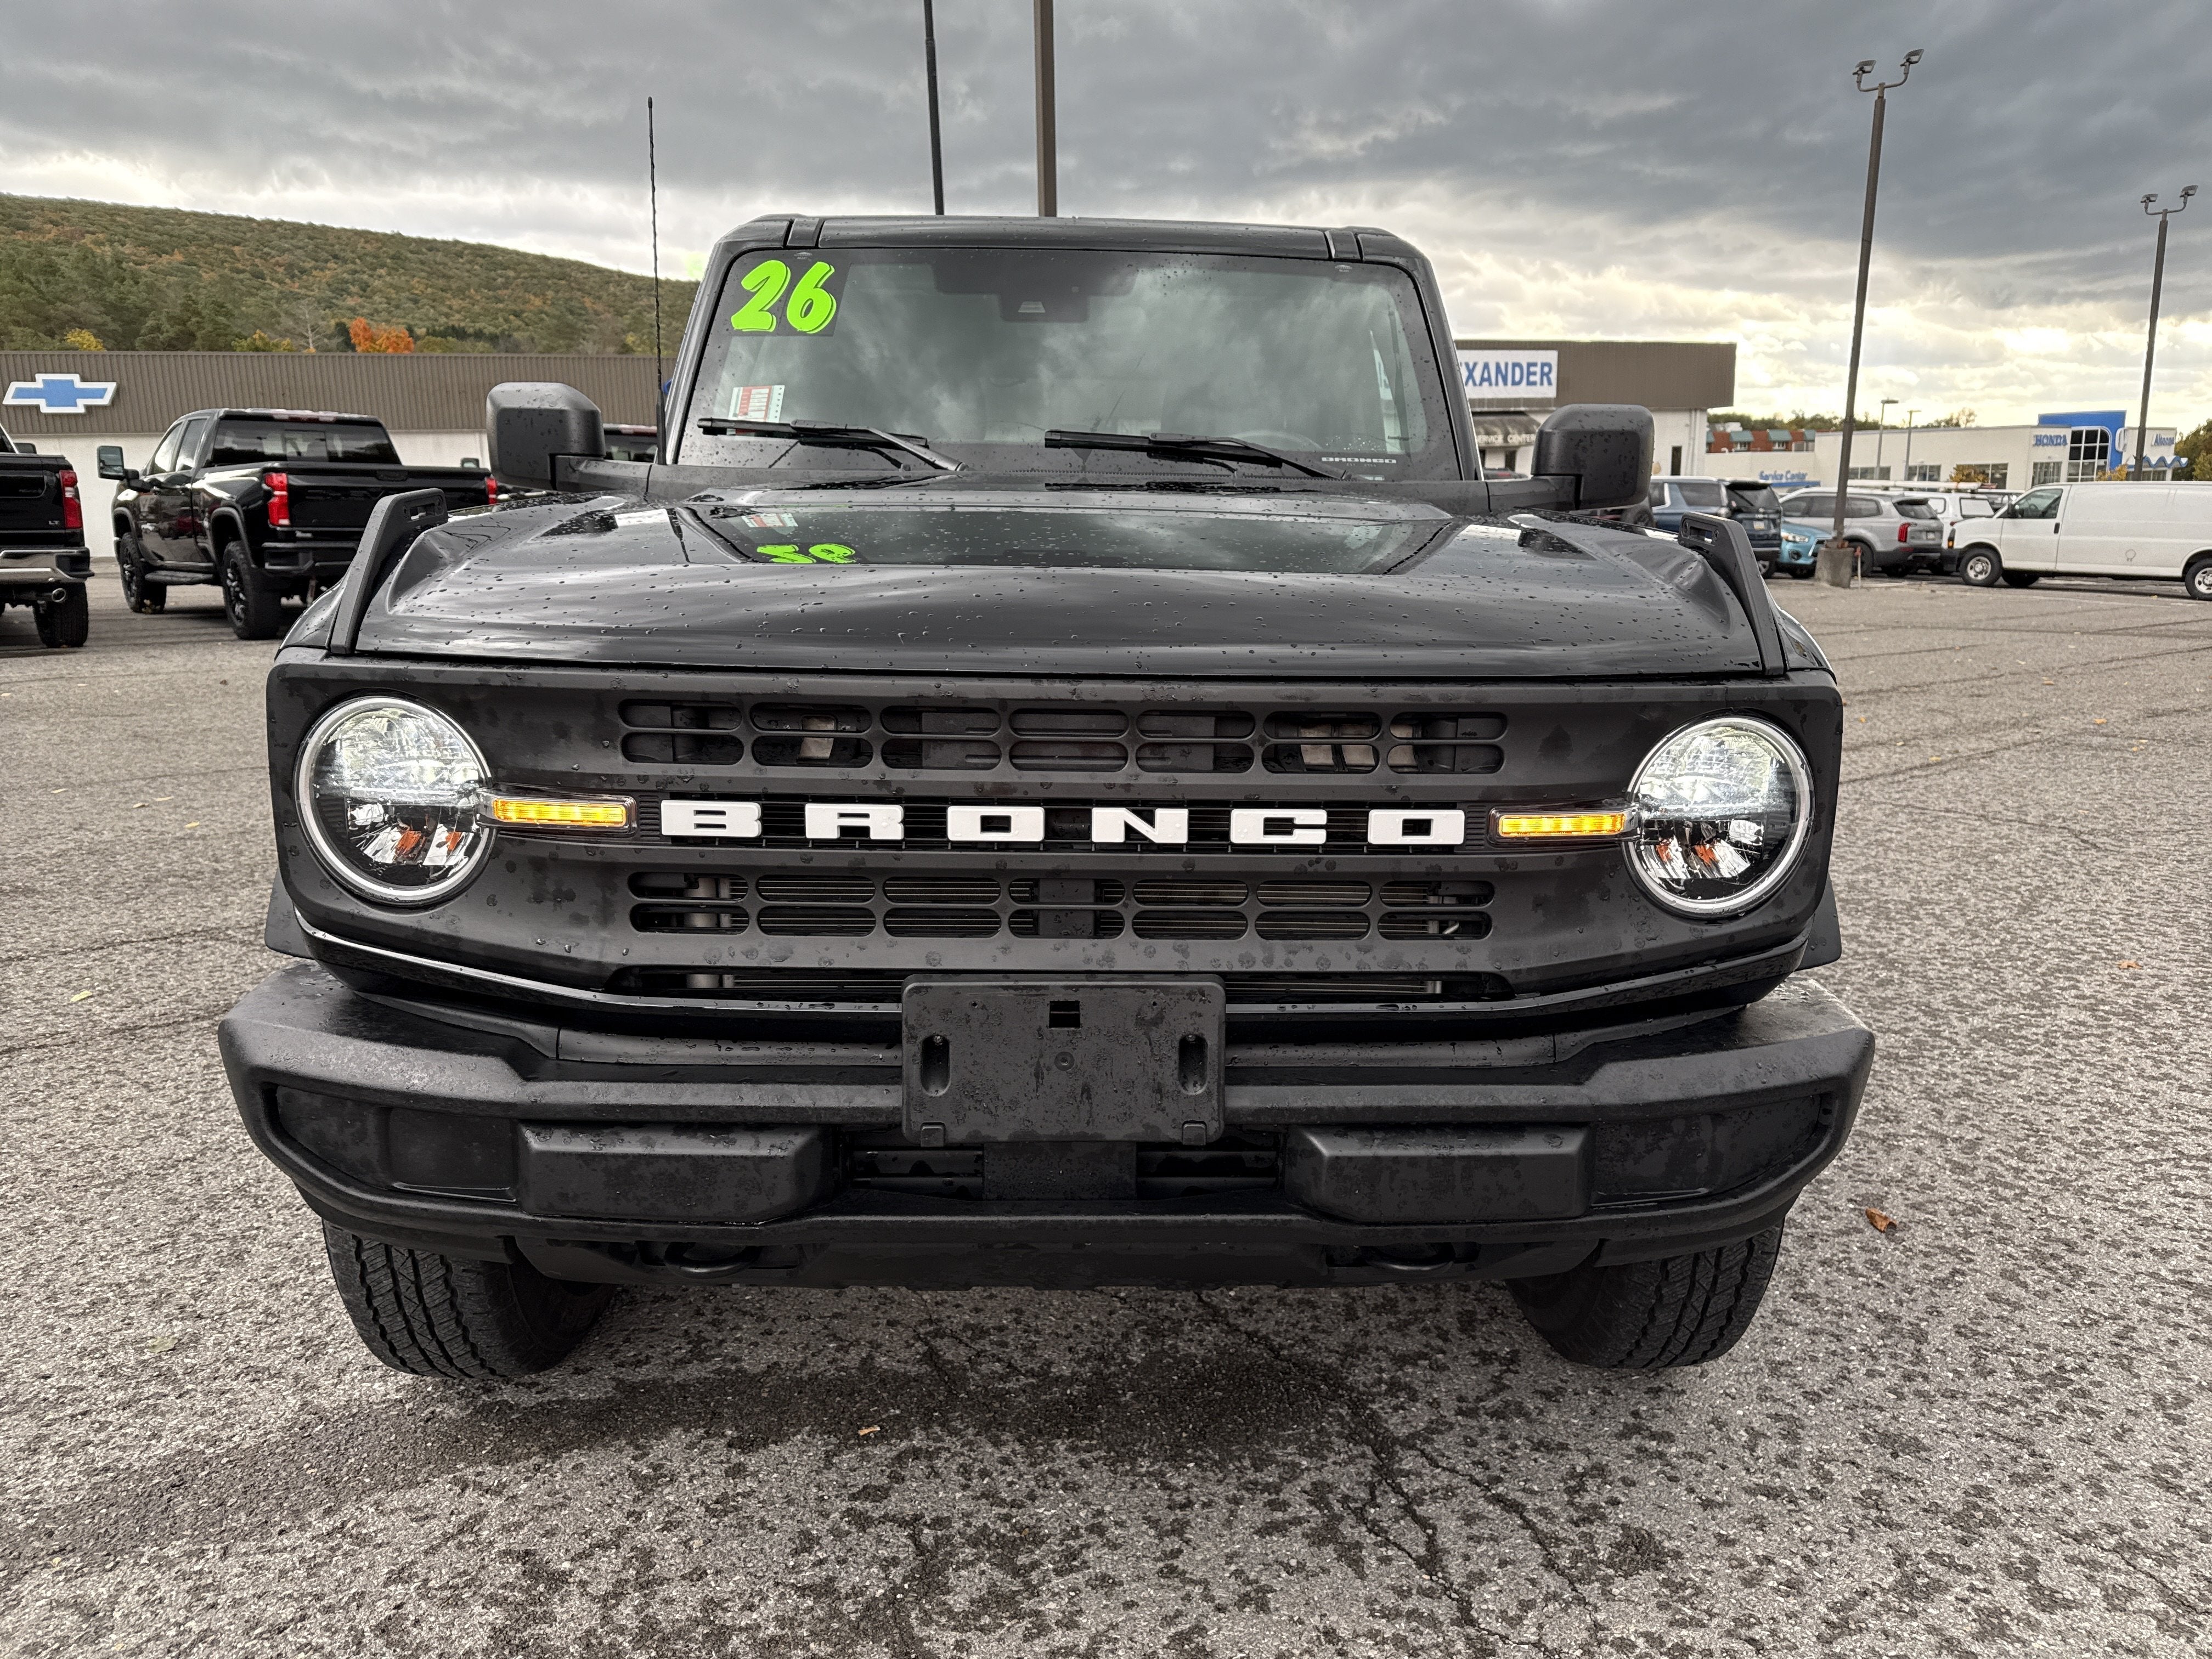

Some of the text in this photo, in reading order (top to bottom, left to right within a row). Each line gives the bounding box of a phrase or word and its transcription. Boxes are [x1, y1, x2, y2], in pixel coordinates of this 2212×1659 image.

[731, 259, 837, 334] 26
[1460, 362, 1553, 386] XANDER
[2035, 434, 2068, 445] HONDA
[660, 799, 1465, 845] BRONCO
